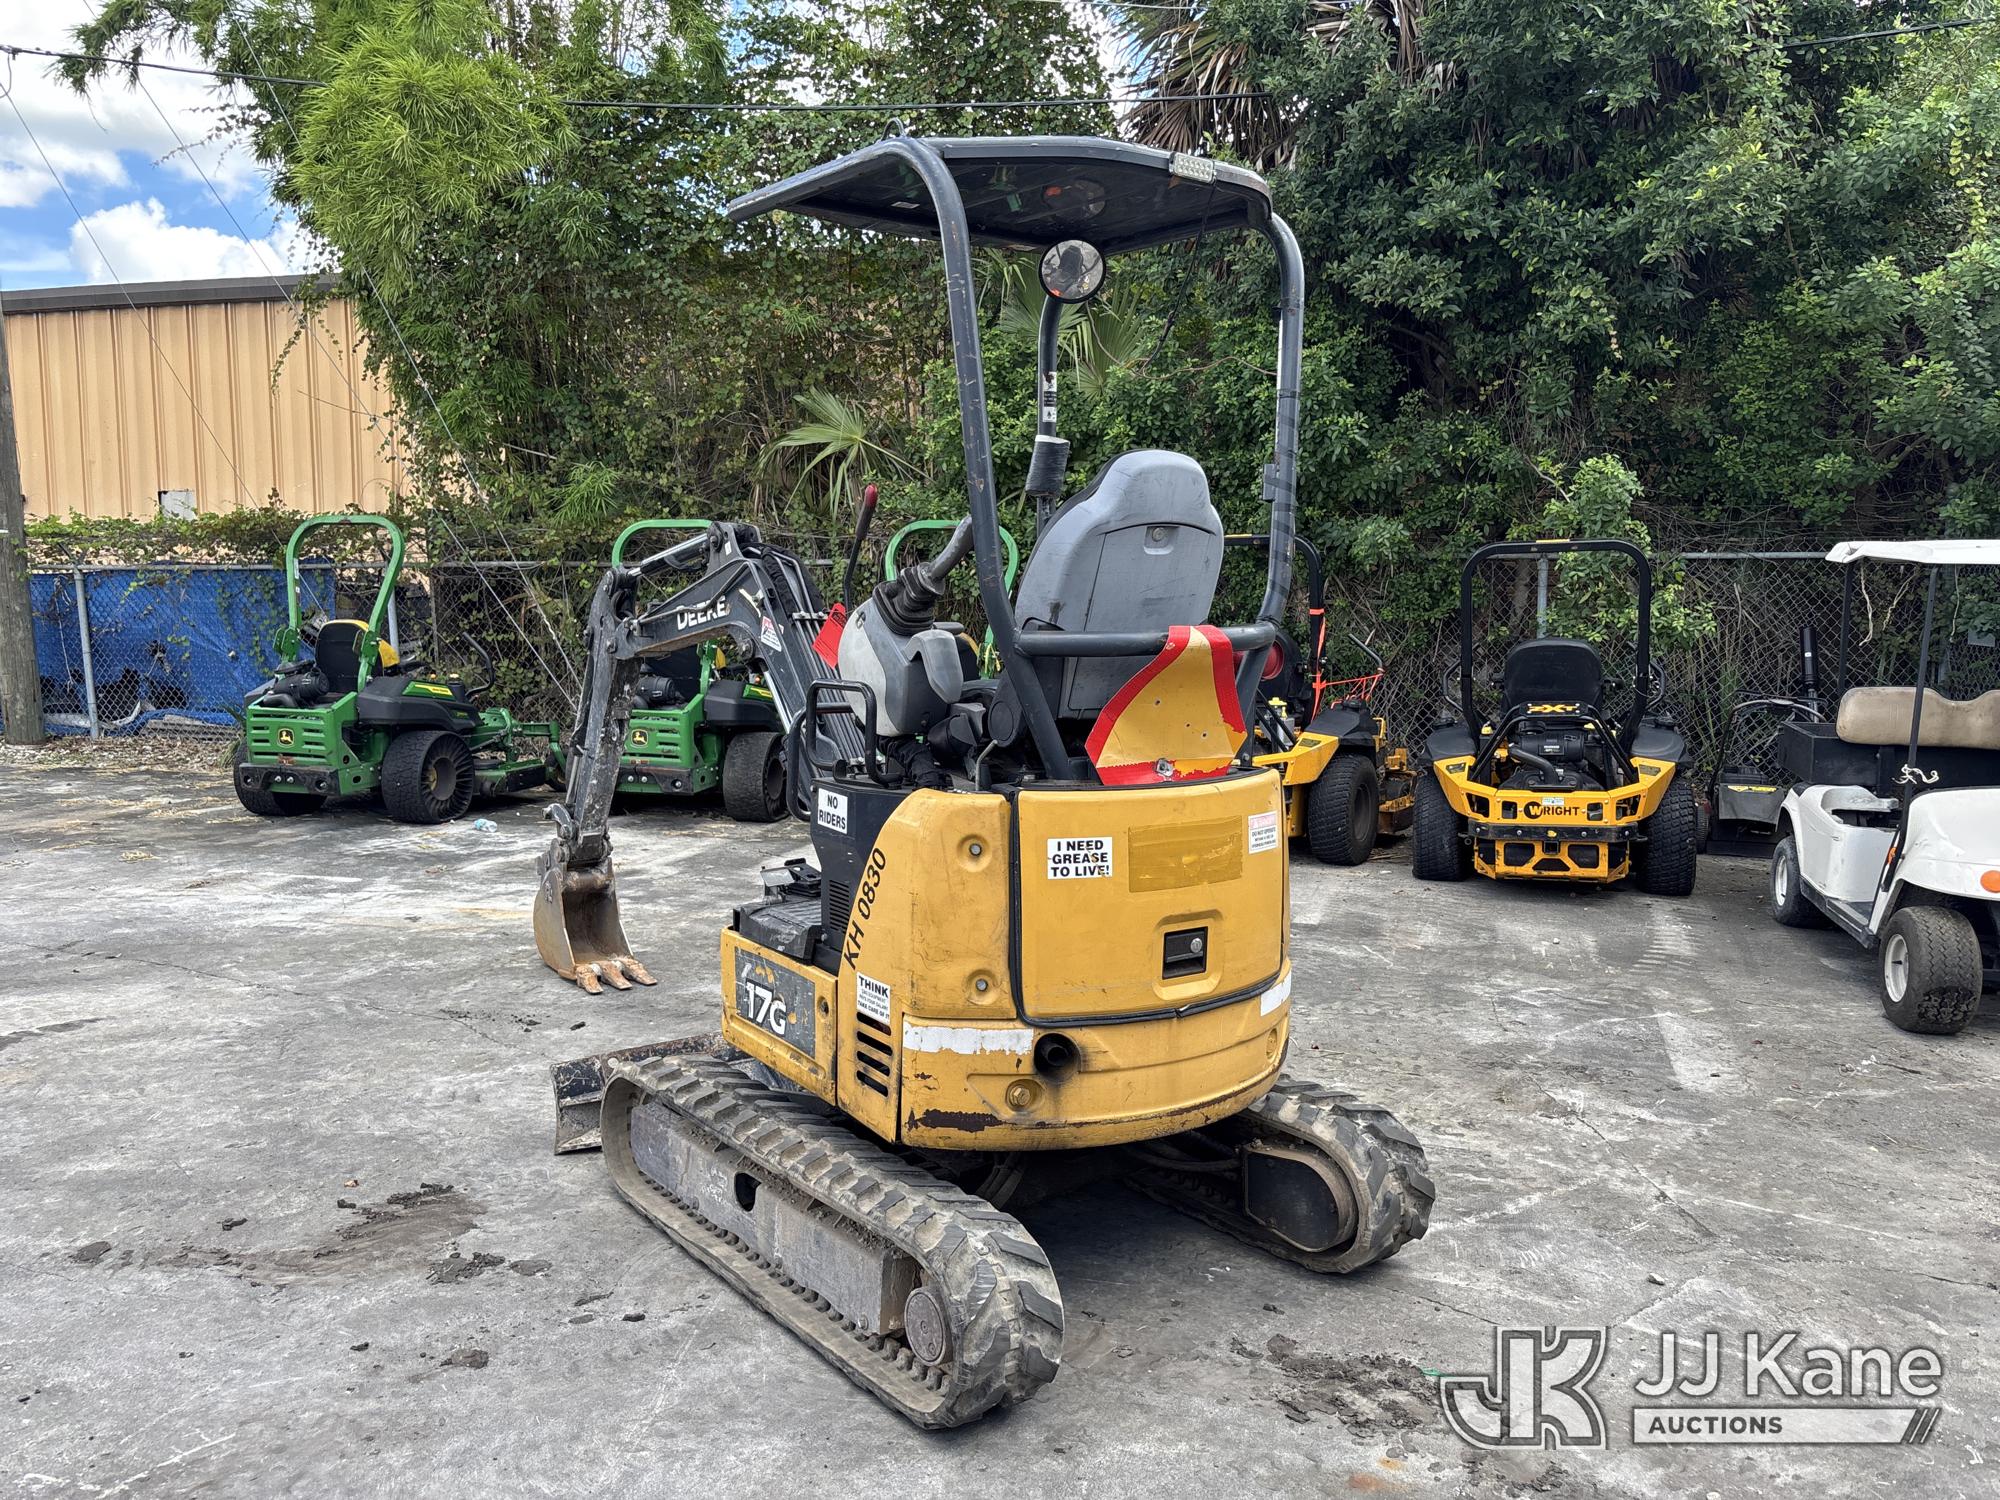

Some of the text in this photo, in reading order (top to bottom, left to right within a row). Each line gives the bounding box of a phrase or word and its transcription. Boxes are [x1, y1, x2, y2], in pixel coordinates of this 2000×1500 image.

[827, 795, 838, 809] NO
[1525, 802, 1580, 818] WRIGHT
[819, 809, 846, 830] RIDERS
[1057, 840, 1104, 851] I NEED
[1052, 852, 1108, 864] GREASE
[1051, 865, 1109, 877] TO LIVE!
[843, 847, 886, 971] KH 0830
[858, 975, 889, 998] THINK
[745, 981, 787, 1035] 17G
